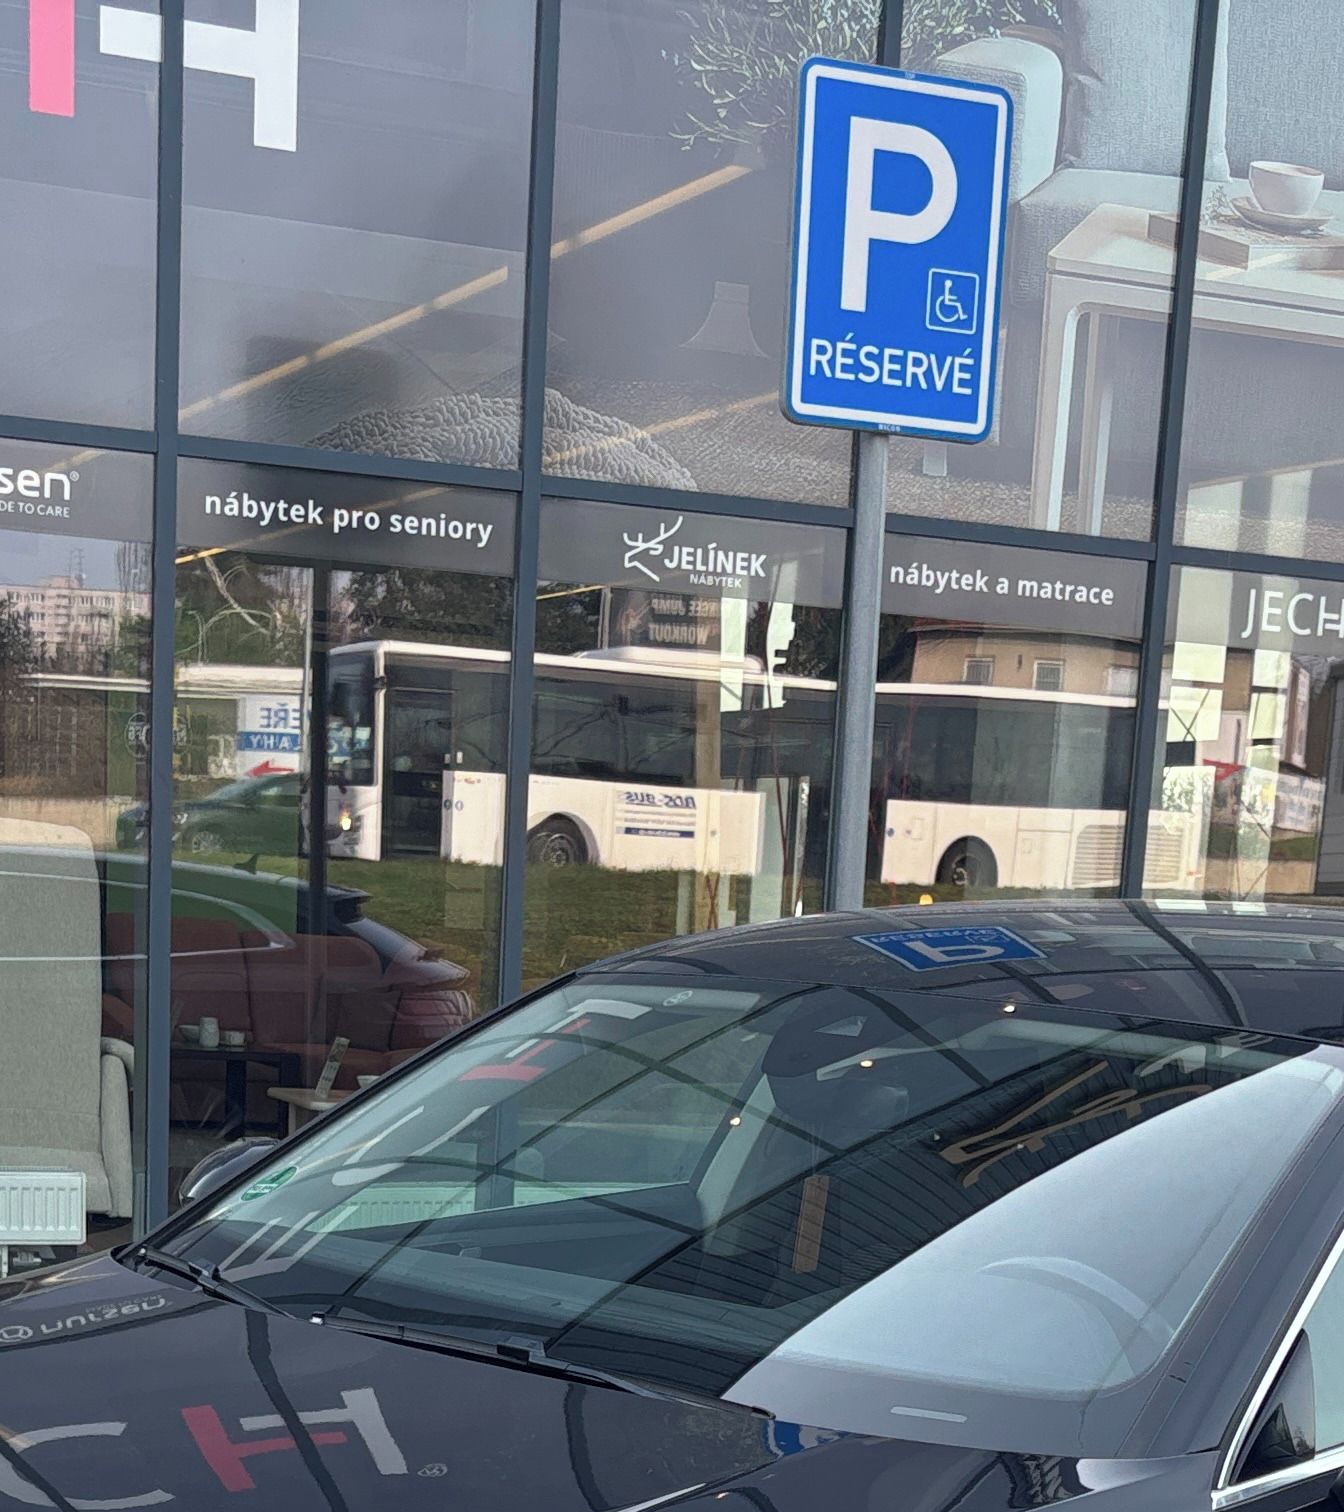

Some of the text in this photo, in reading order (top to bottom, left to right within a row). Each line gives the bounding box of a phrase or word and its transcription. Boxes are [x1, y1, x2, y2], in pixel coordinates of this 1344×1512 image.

[840, 115, 957, 313] P
[809, 332, 975, 395] RÉSERVÉ
[17, 502, 35, 514] TO
[37, 504, 70, 518] CARE
[205, 491, 493, 548] nábytek pro seniory
[663, 542, 767, 577] JELÍNEK
[689, 573, 743, 588] NÁBYTEK
[890, 562, 1114, 605] nábytek a matrace
